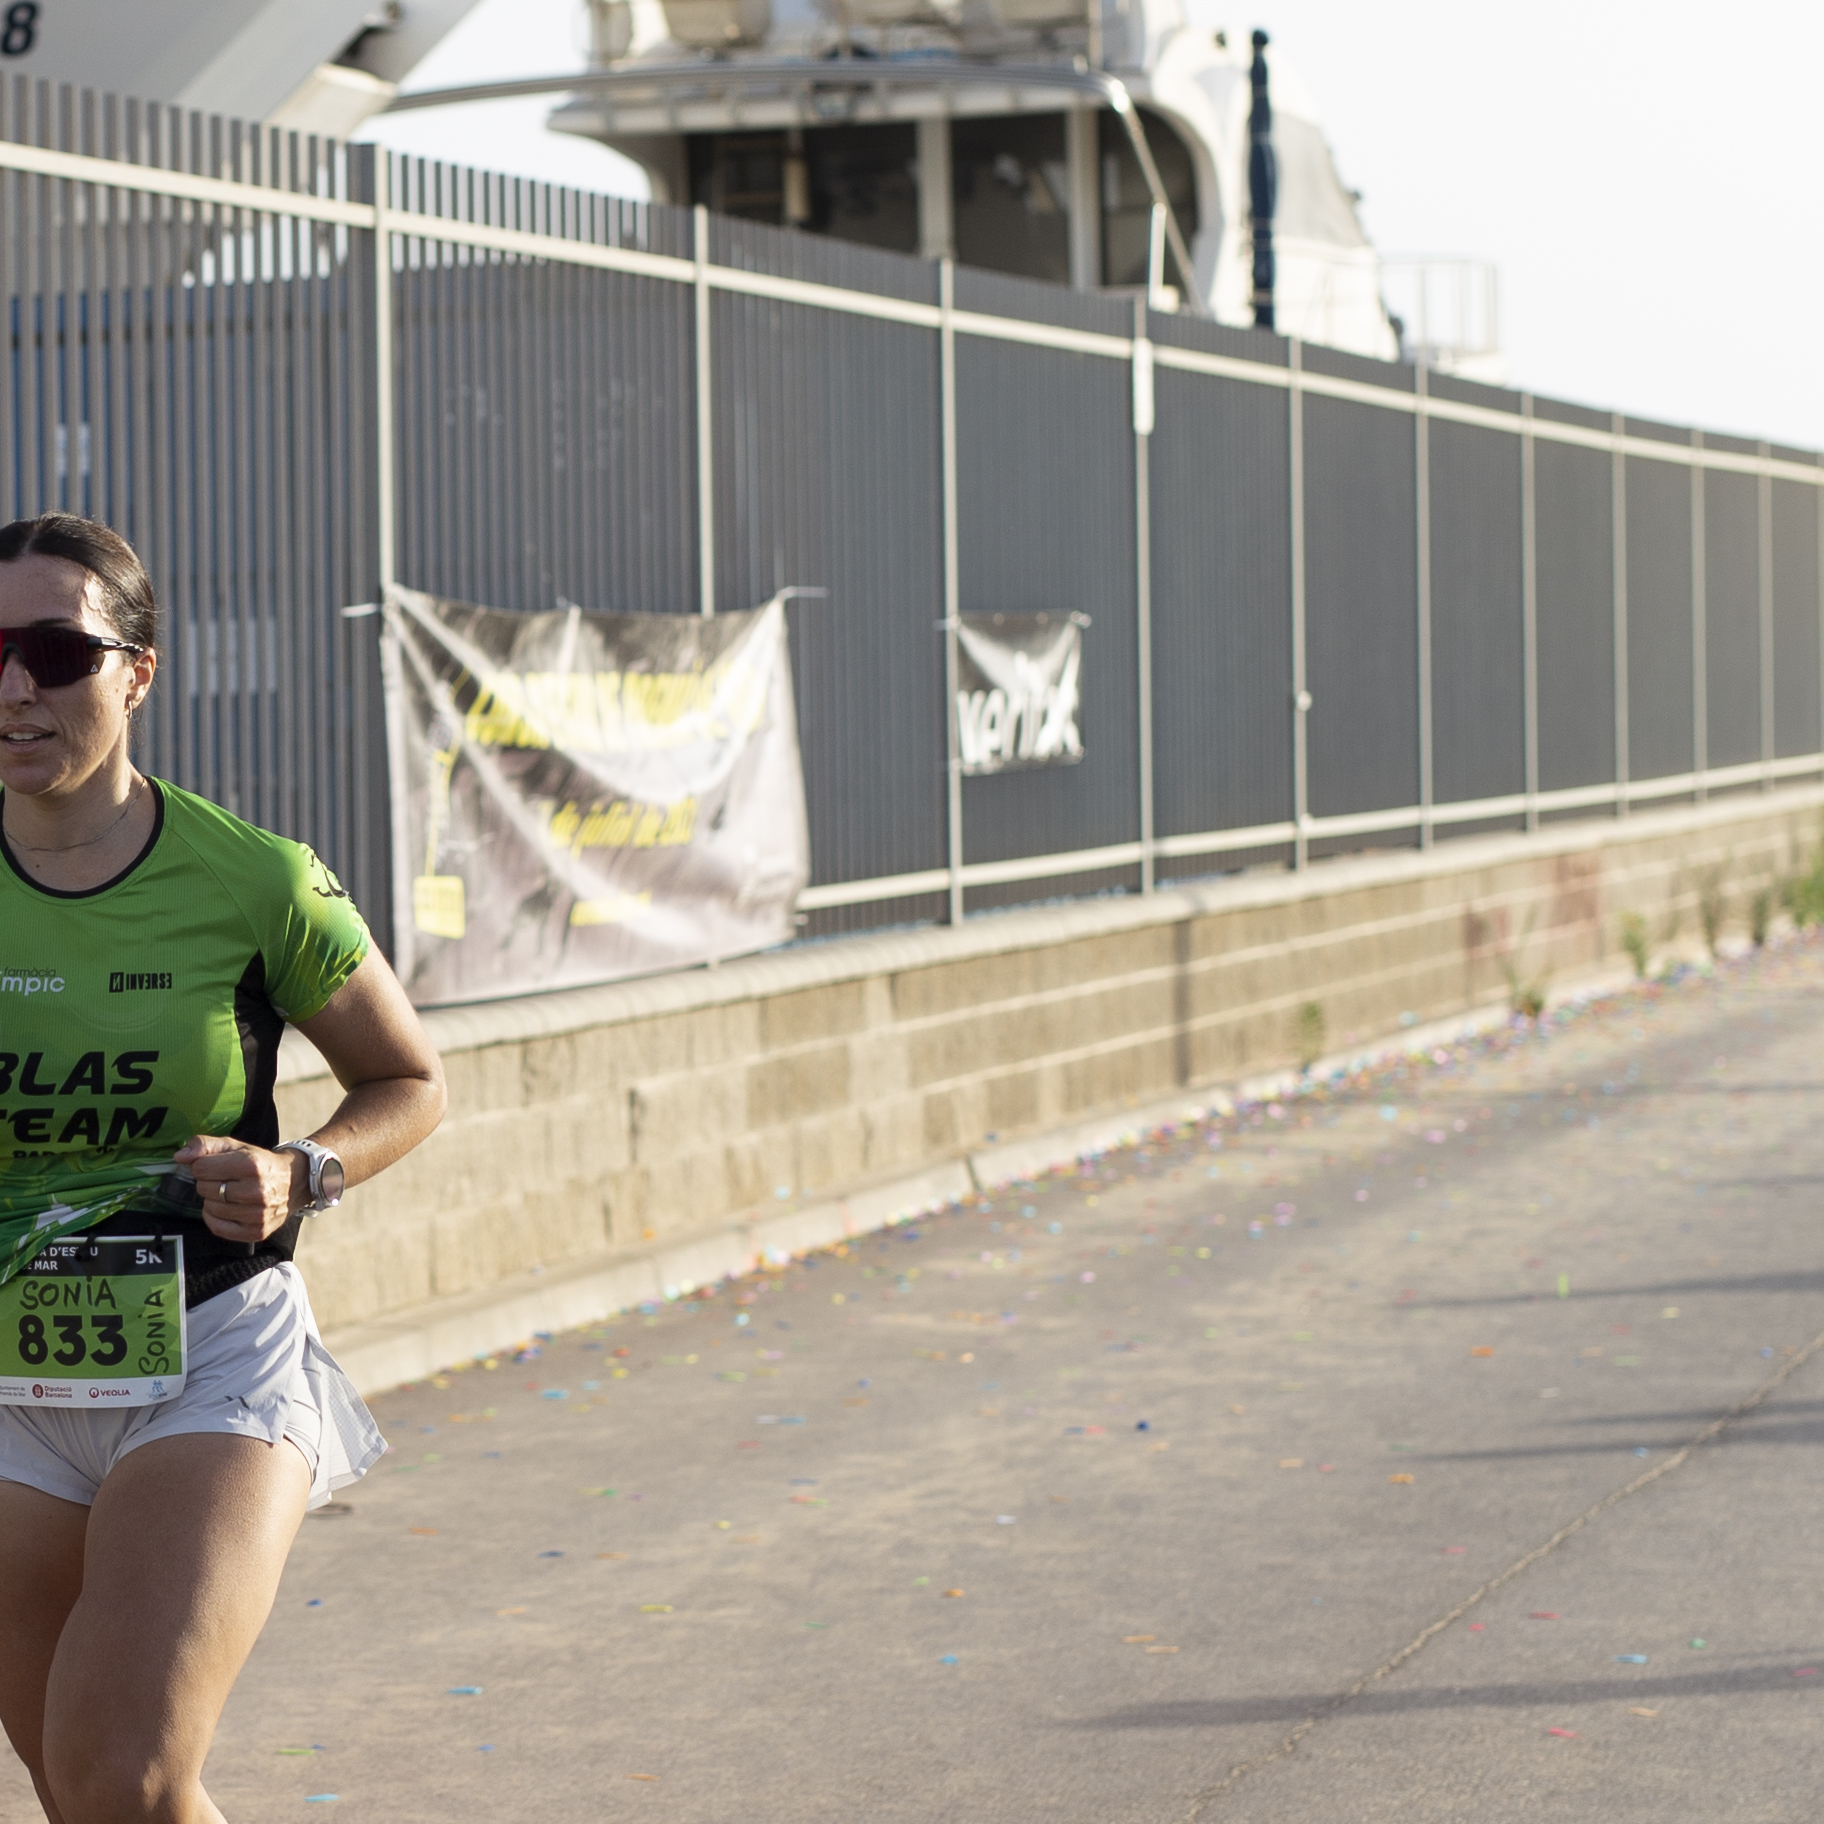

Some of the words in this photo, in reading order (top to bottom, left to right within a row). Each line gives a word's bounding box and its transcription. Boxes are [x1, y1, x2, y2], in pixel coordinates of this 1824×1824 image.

[33, 1260, 59, 1271] MAR
[18, 1314, 128, 1367] 833
[100, 1389, 130, 1397] VEOLIA
